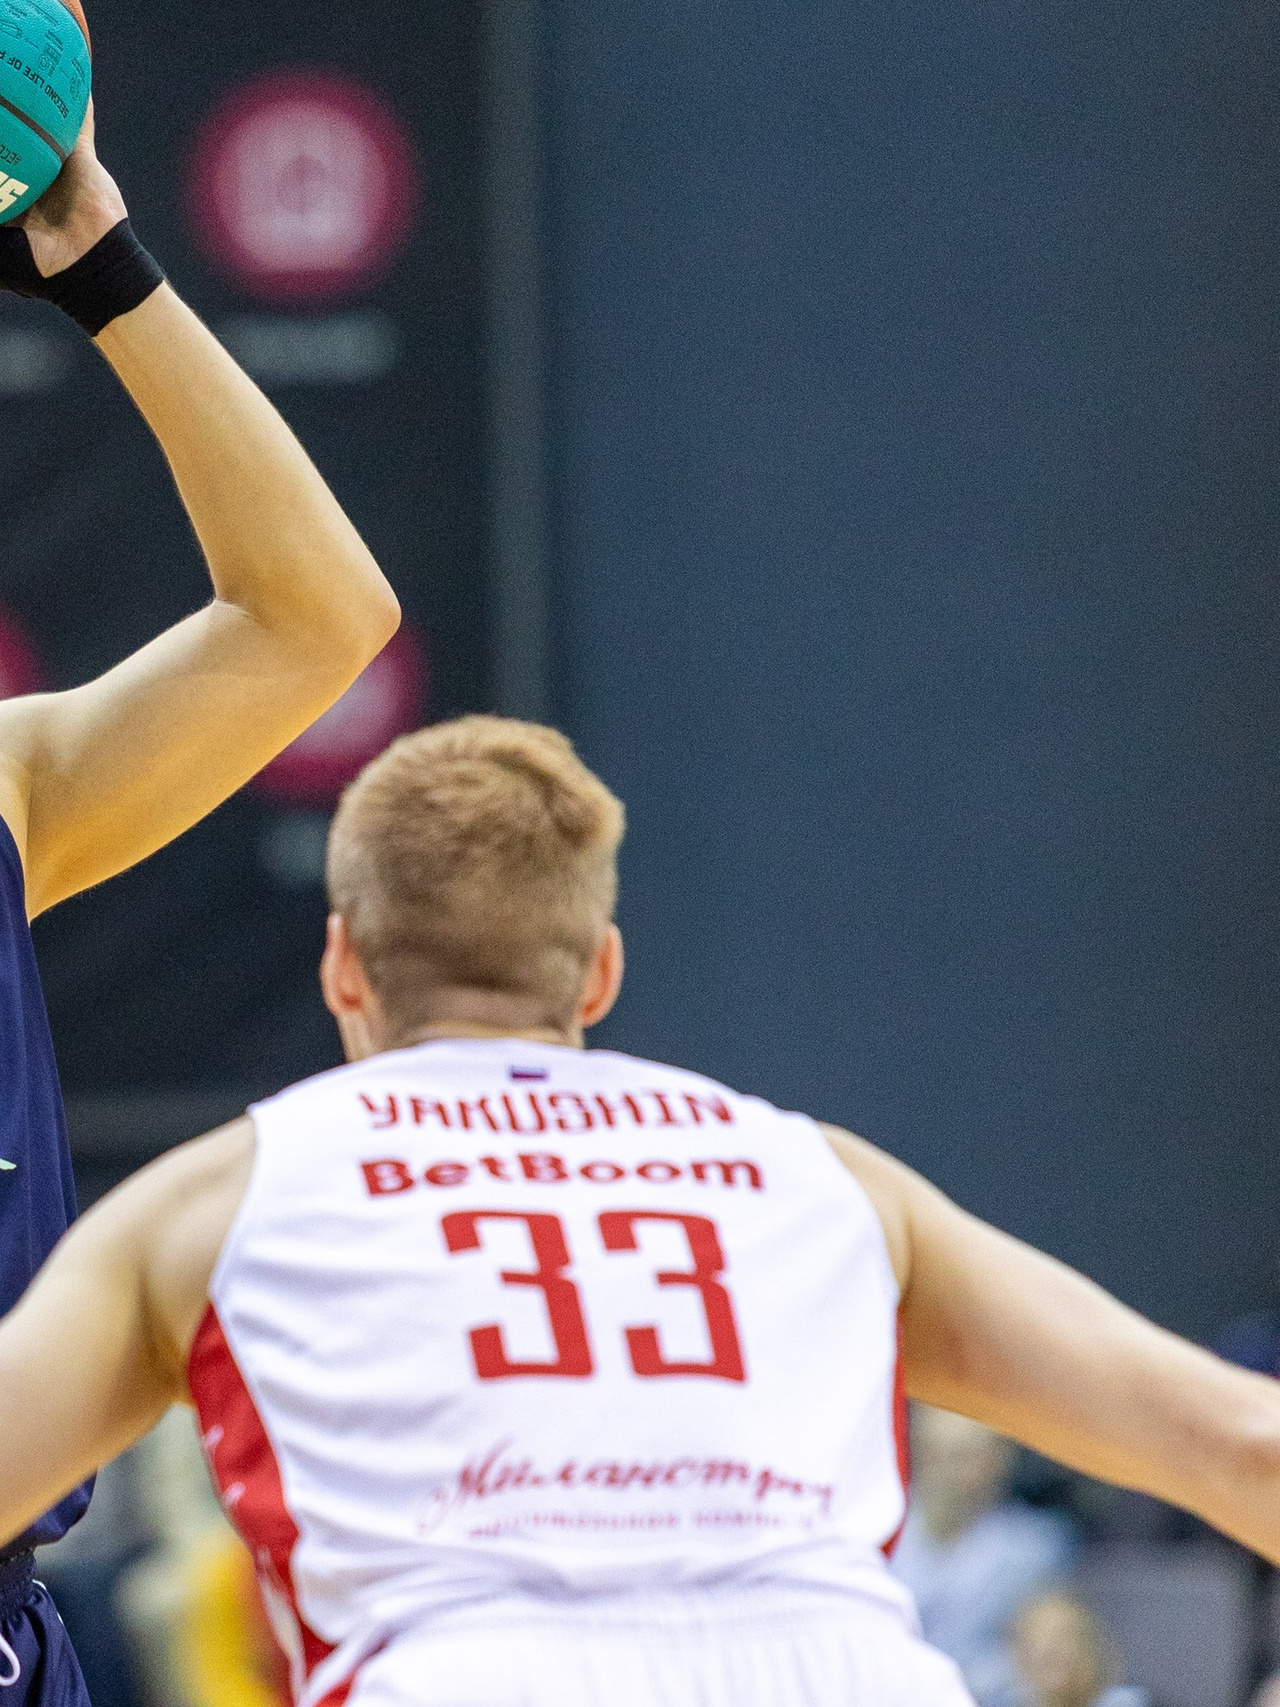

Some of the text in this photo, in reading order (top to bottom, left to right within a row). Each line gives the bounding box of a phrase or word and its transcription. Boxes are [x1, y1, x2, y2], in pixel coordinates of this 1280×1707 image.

[7, 57, 22, 71] OF
[23, 66, 45, 87] LIFE
[44, 84, 70, 118] SECOND
[358, 1091, 734, 1133] YAKUSHIN
[360, 1150, 765, 1198] BetBoom
[440, 1210, 749, 1384] 33
